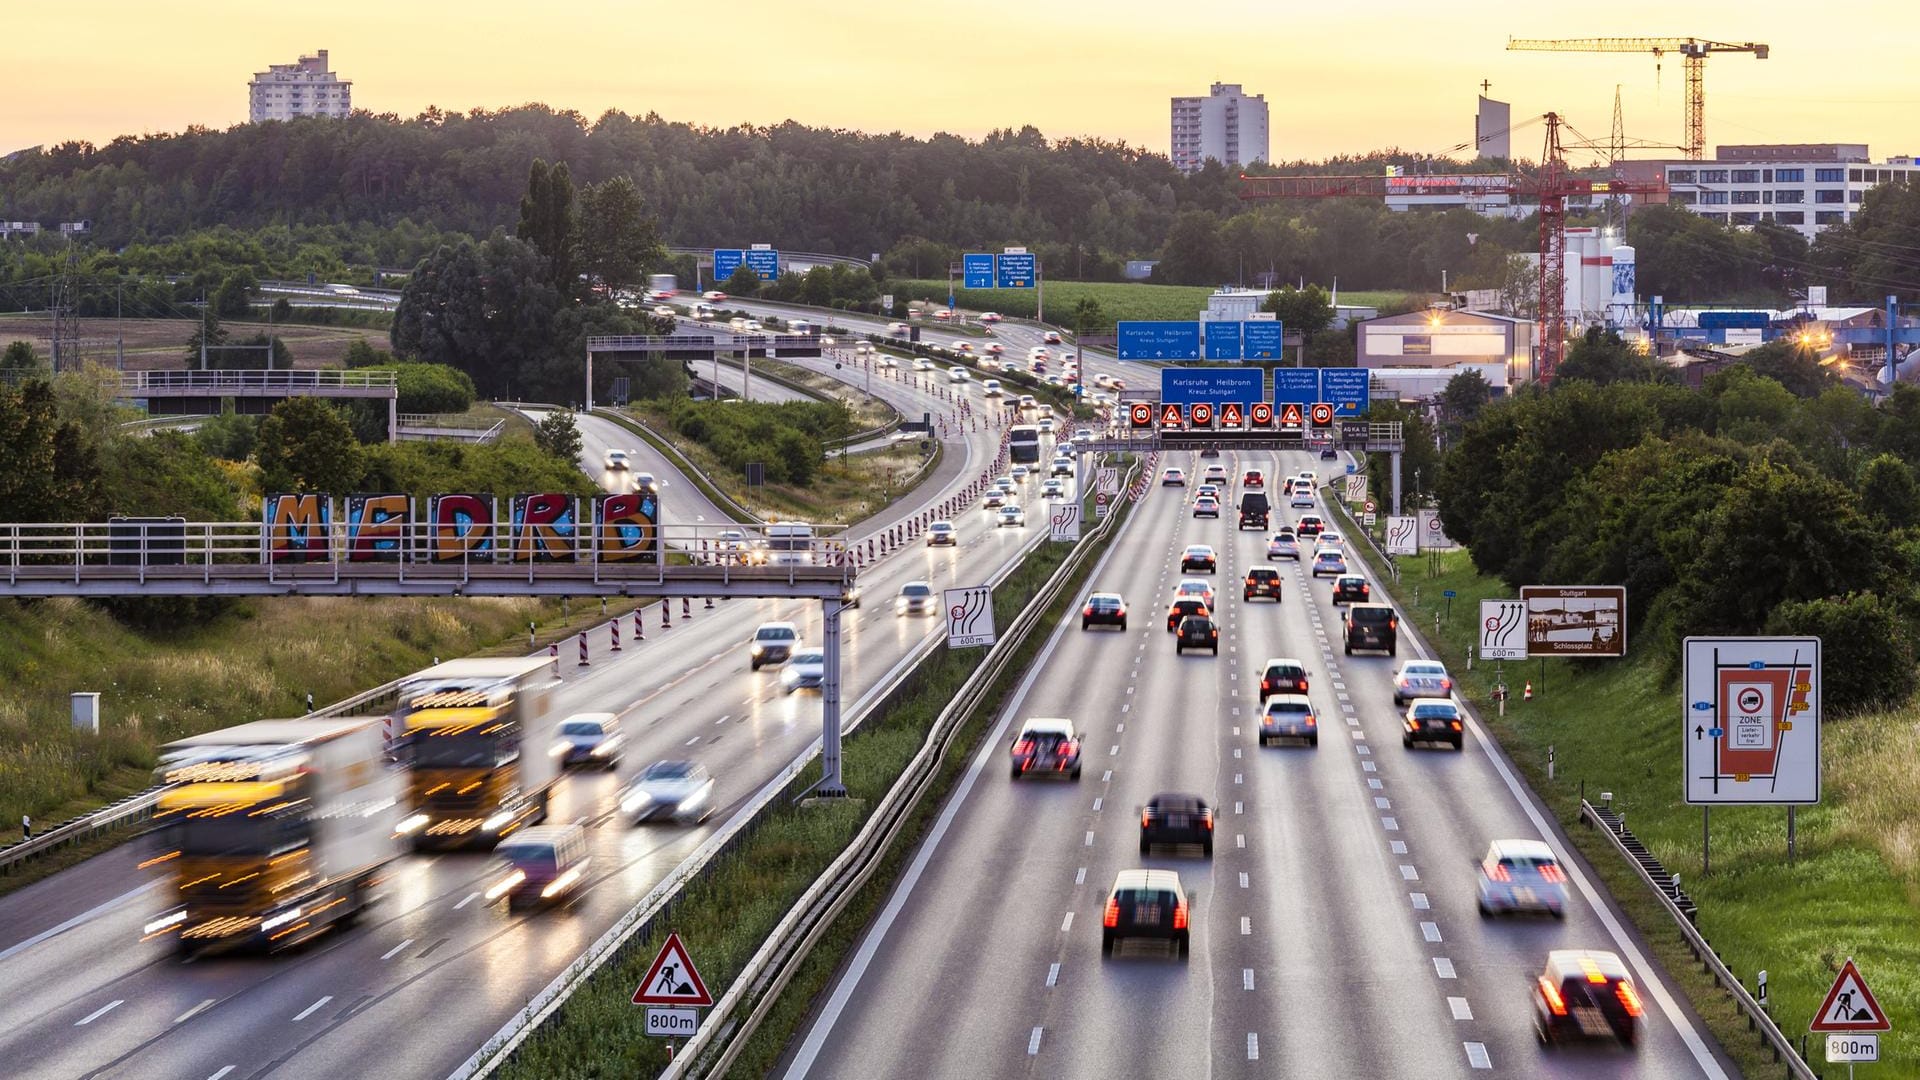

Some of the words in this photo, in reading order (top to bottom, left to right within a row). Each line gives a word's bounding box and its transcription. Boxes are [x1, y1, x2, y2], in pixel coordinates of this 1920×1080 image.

[1136, 410, 1146, 418] 80
[1196, 409, 1207, 418] 80
[1256, 409, 1267, 417] 80
[1316, 409, 1328, 418] 80
[1560, 590, 1587, 598] Stuttgart
[960, 636, 975, 645] 600
[1553, 642, 1593, 651] Schlossplatz
[1492, 649, 1506, 657] 600
[1739, 716, 1762, 724] ZONE
[650, 1014, 693, 1029] 800m
[1831, 1041, 1874, 1054] 800m
